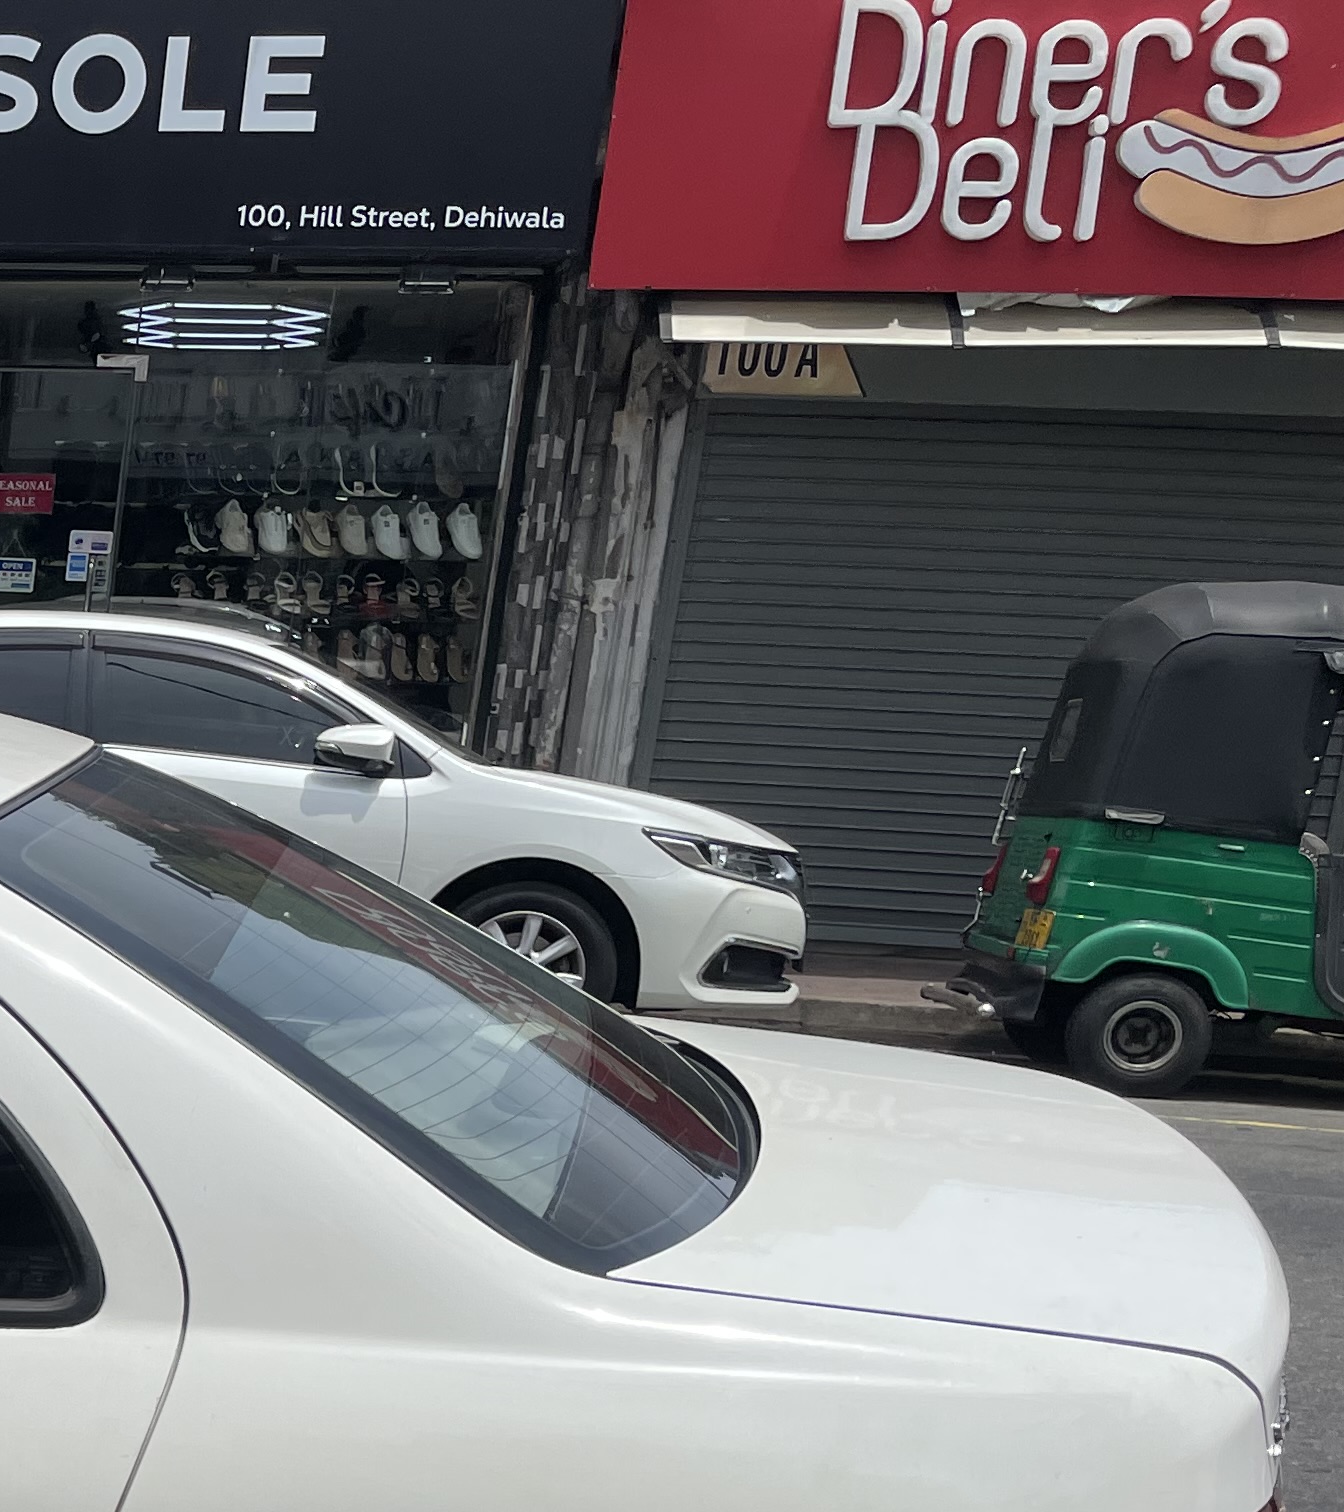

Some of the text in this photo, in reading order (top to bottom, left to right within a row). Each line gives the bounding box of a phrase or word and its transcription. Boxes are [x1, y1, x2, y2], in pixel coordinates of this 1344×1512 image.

[827, 0, 1290, 128] Diner's
[843, 108, 1110, 242] Deli
[237, 204, 565, 231] 100, Hill Street, Dehiwala
[5, 496, 35, 507] SALE
